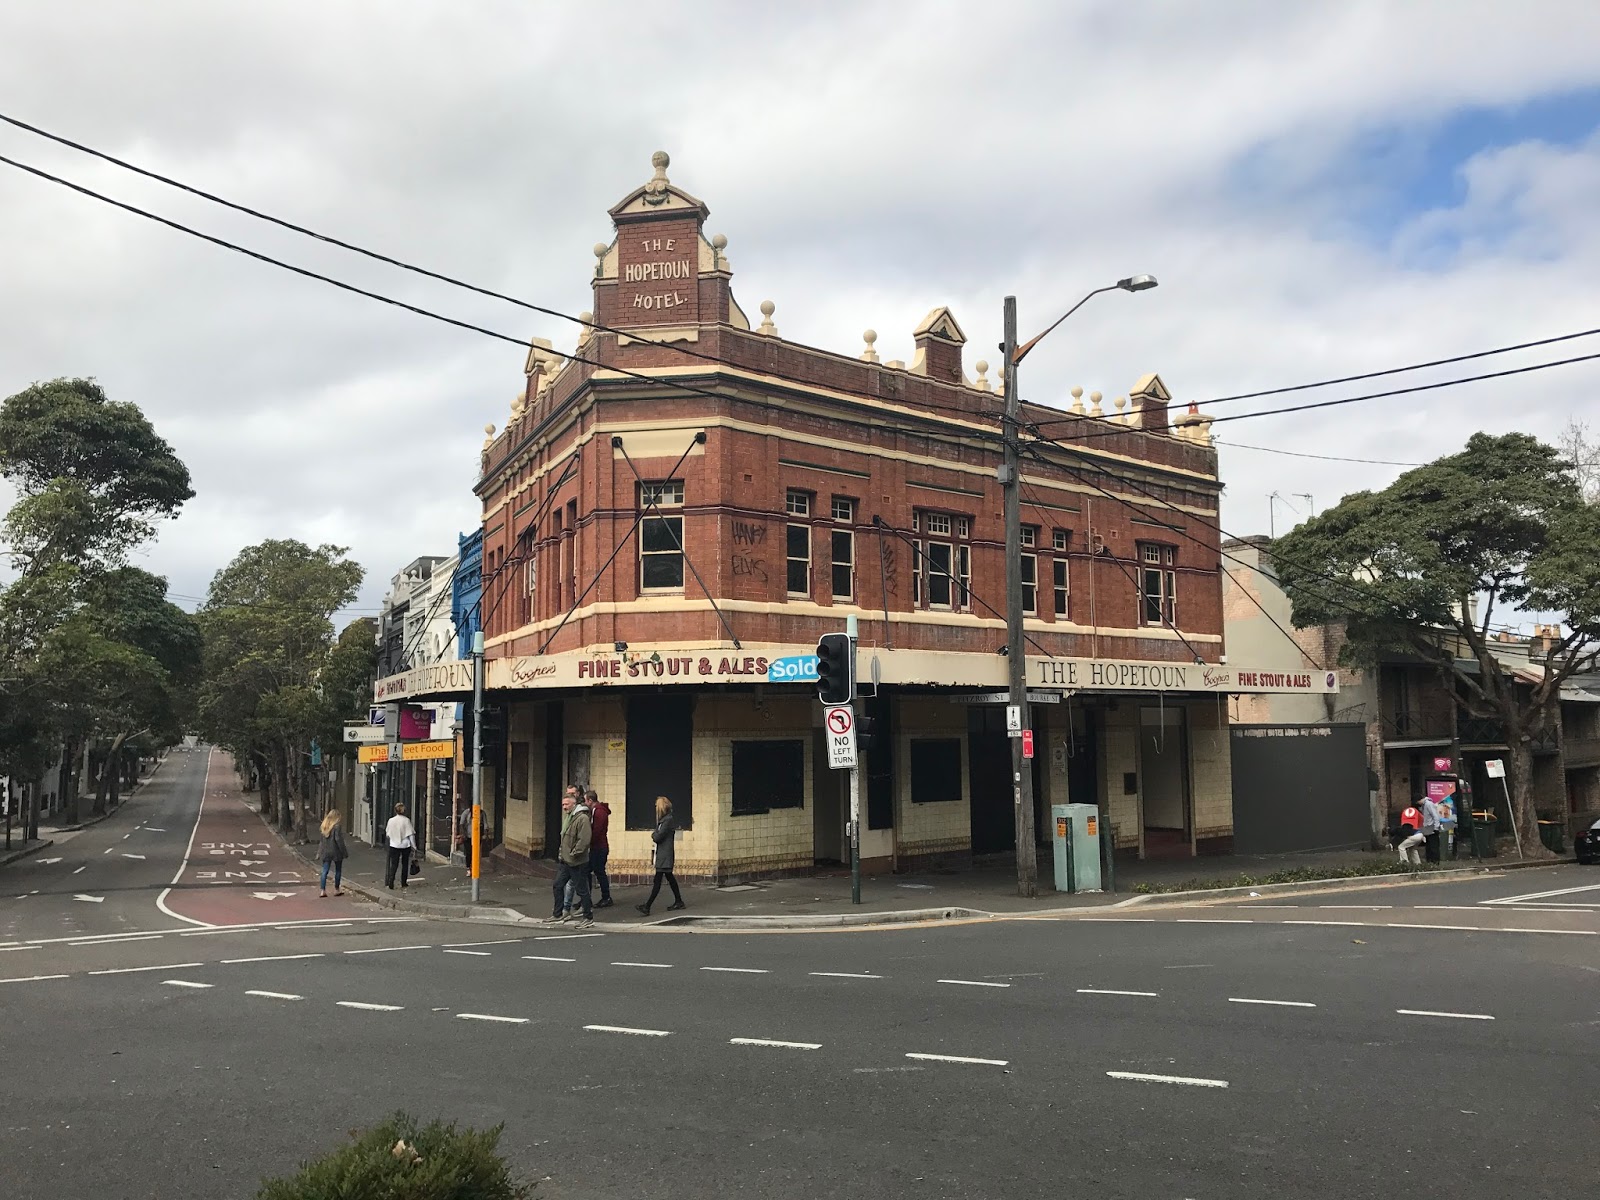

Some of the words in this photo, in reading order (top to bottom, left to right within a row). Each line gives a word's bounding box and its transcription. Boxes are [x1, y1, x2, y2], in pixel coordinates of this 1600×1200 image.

[641, 238, 676, 252] THE
[625, 260, 690, 282] HOPETOUN
[633, 291, 688, 310] HOTEL.
[578, 660, 621, 678] FINE
[628, 657, 693, 677] STOUT
[699, 657, 712, 675] &
[718, 657, 768, 675] ALES
[772, 658, 817, 678] Sold
[1037, 661, 1078, 684] THE
[1090, 663, 1186, 687] HOPETOUN
[417, 663, 474, 691] HOPETOUN
[1238, 672, 1257, 687] FINE
[1260, 673, 1284, 687] STOUT
[1286, 675, 1292, 687] &
[1294, 675, 1311, 687] ALES
[420, 744, 444, 753] Food
[834, 736, 849, 746] NO
[833, 747, 851, 755] LEFT
[196, 871, 302, 879] LANE
